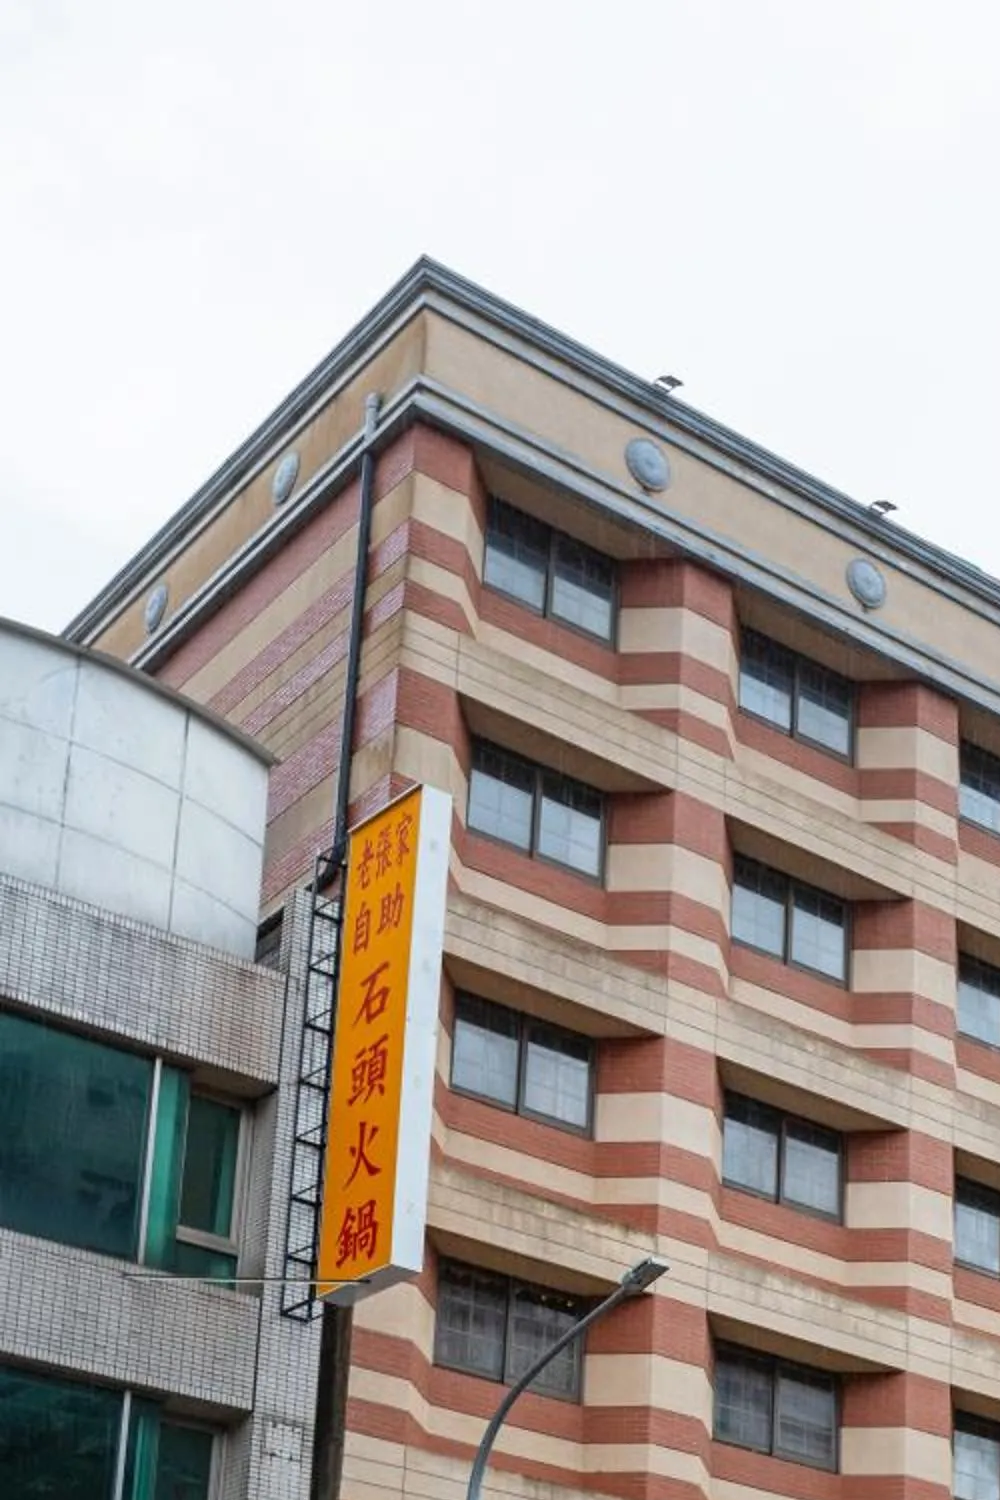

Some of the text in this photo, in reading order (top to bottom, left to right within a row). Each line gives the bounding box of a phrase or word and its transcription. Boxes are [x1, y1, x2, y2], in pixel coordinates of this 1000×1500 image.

[357, 814, 413, 889] 老張家
[354, 882, 404, 955] 自助
[335, 962, 391, 1270] 石頭火鍋
